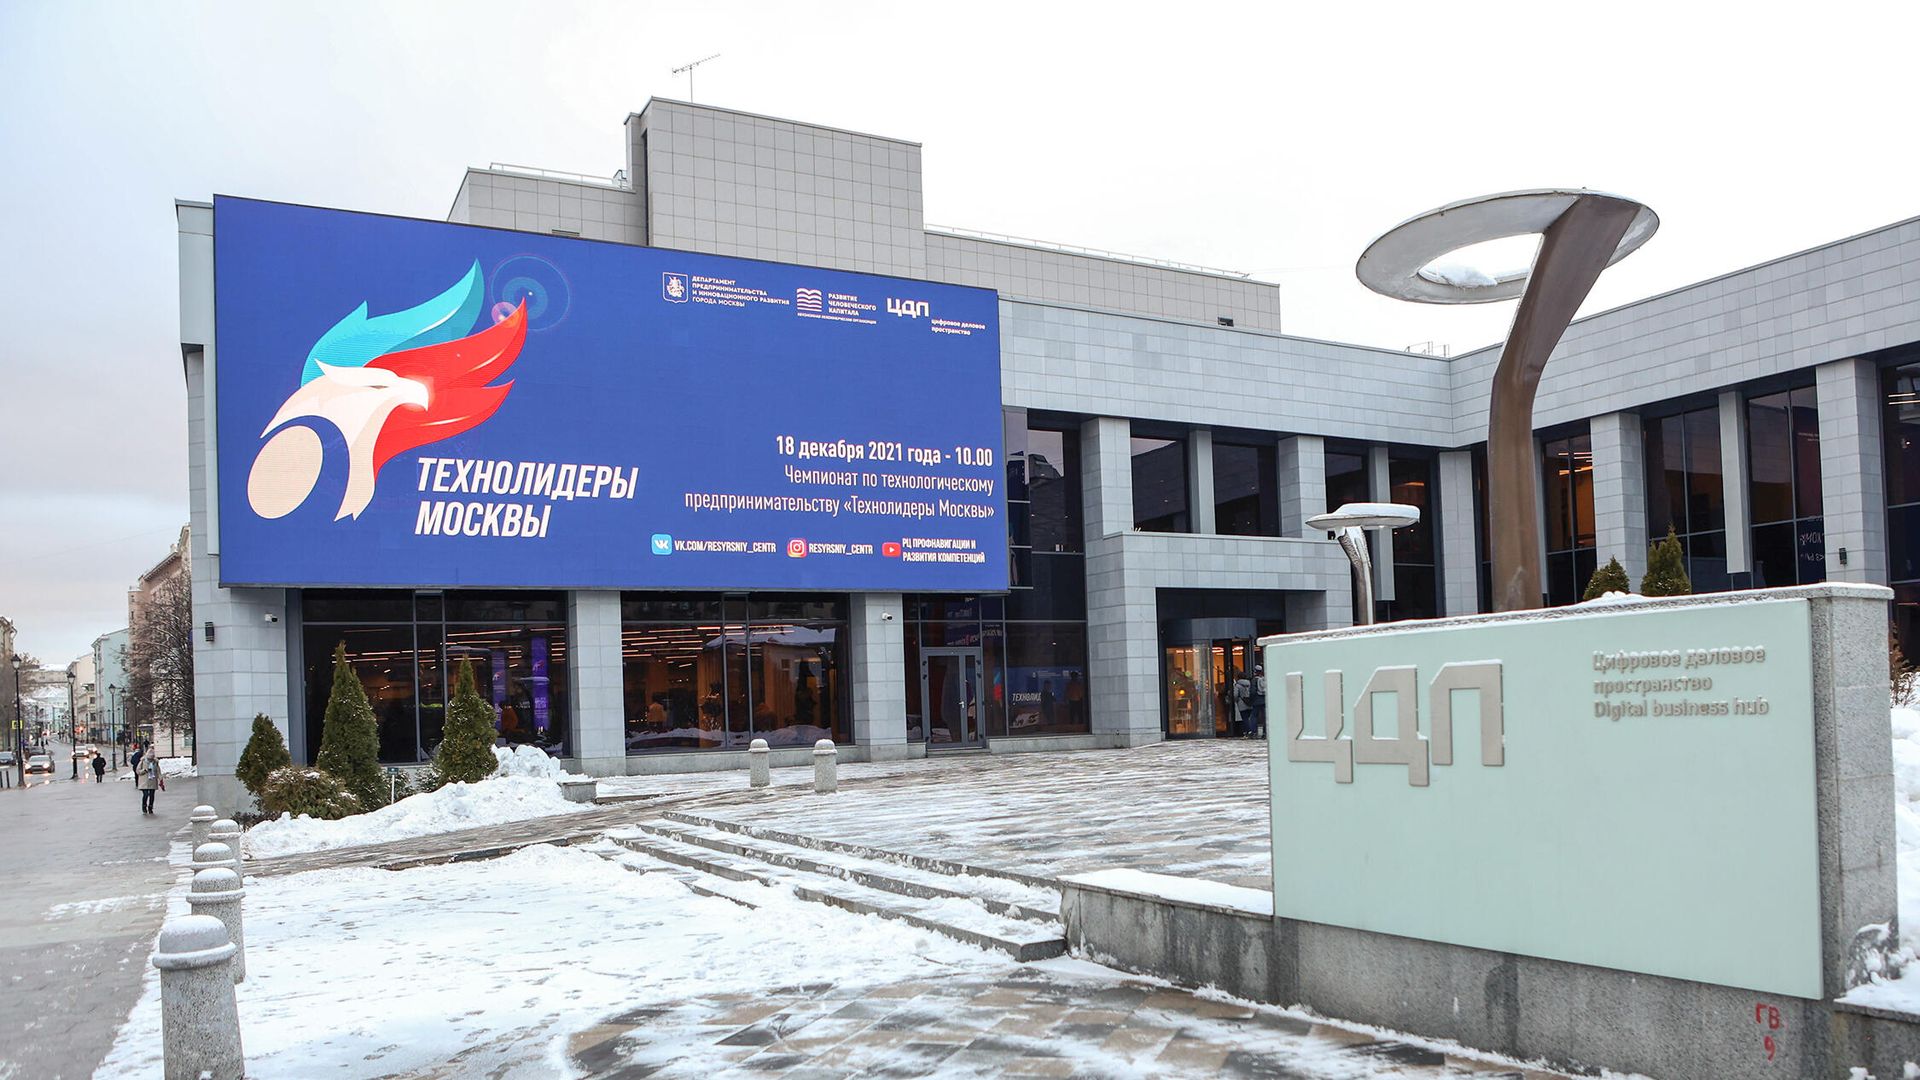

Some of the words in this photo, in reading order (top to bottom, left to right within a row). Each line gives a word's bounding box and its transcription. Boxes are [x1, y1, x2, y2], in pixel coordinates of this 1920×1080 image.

[691, 276, 736, 286] ДЕПАРТАМЕНТ
[692, 283, 768, 296] ПРЕДПРИНИМАТЕЛЬСТВА
[692, 297, 717, 305] ГОРОДА
[718, 299, 746, 307] МОСКВЫ
[698, 290, 758, 302] ИННОВАЦИОННОГО
[759, 297, 790, 305] РАЗВИТИЯ
[828, 293, 858, 302] РАЗВИТИЕ
[828, 301, 877, 311] ЧЕЛОВЕЧЕСКОГО
[828, 308, 859, 317] КАПИТАЛА
[887, 297, 930, 318] ЦДП
[931, 318, 961, 328] цифровое
[961, 322, 986, 330] деловое
[931, 326, 971, 336] пространство
[776, 435, 795, 456] 18
[798, 440, 864, 462] декабря
[868, 441, 903, 462] 2021
[907, 447, 941, 466] года
[955, 446, 993, 467] 10.00
[417, 457, 640, 501] ТЕХНОЛИДЕРЫ
[784, 464, 858, 487] Чемпионат
[862, 472, 878, 487] по
[881, 474, 994, 497] технологическому
[684, 492, 840, 517] предпринимательству
[843, 495, 935, 520] «Технолидеры
[938, 498, 995, 519] Москвы»
[414, 500, 552, 538] МОСКВЫ
[902, 537, 912, 549] РЦ
[912, 538, 970, 550] ПРОФНАВИГАЦИИ
[971, 539, 977, 549] И
[902, 552, 937, 562] РАЗВИТИЯ
[937, 552, 986, 564] КОМПЕТЕНЦИЙ
[1592, 650, 1681, 674] Цифровое
[1684, 645, 1766, 669] деловое
[1593, 676, 1713, 698] пространство
[1012, 692, 1042, 702] ТЕХНОЛИД
[1594, 700, 1648, 721] Digital
[1652, 699, 1729, 717] business
[1732, 695, 1769, 715] hub
[1286, 658, 1505, 787] ЦДП
